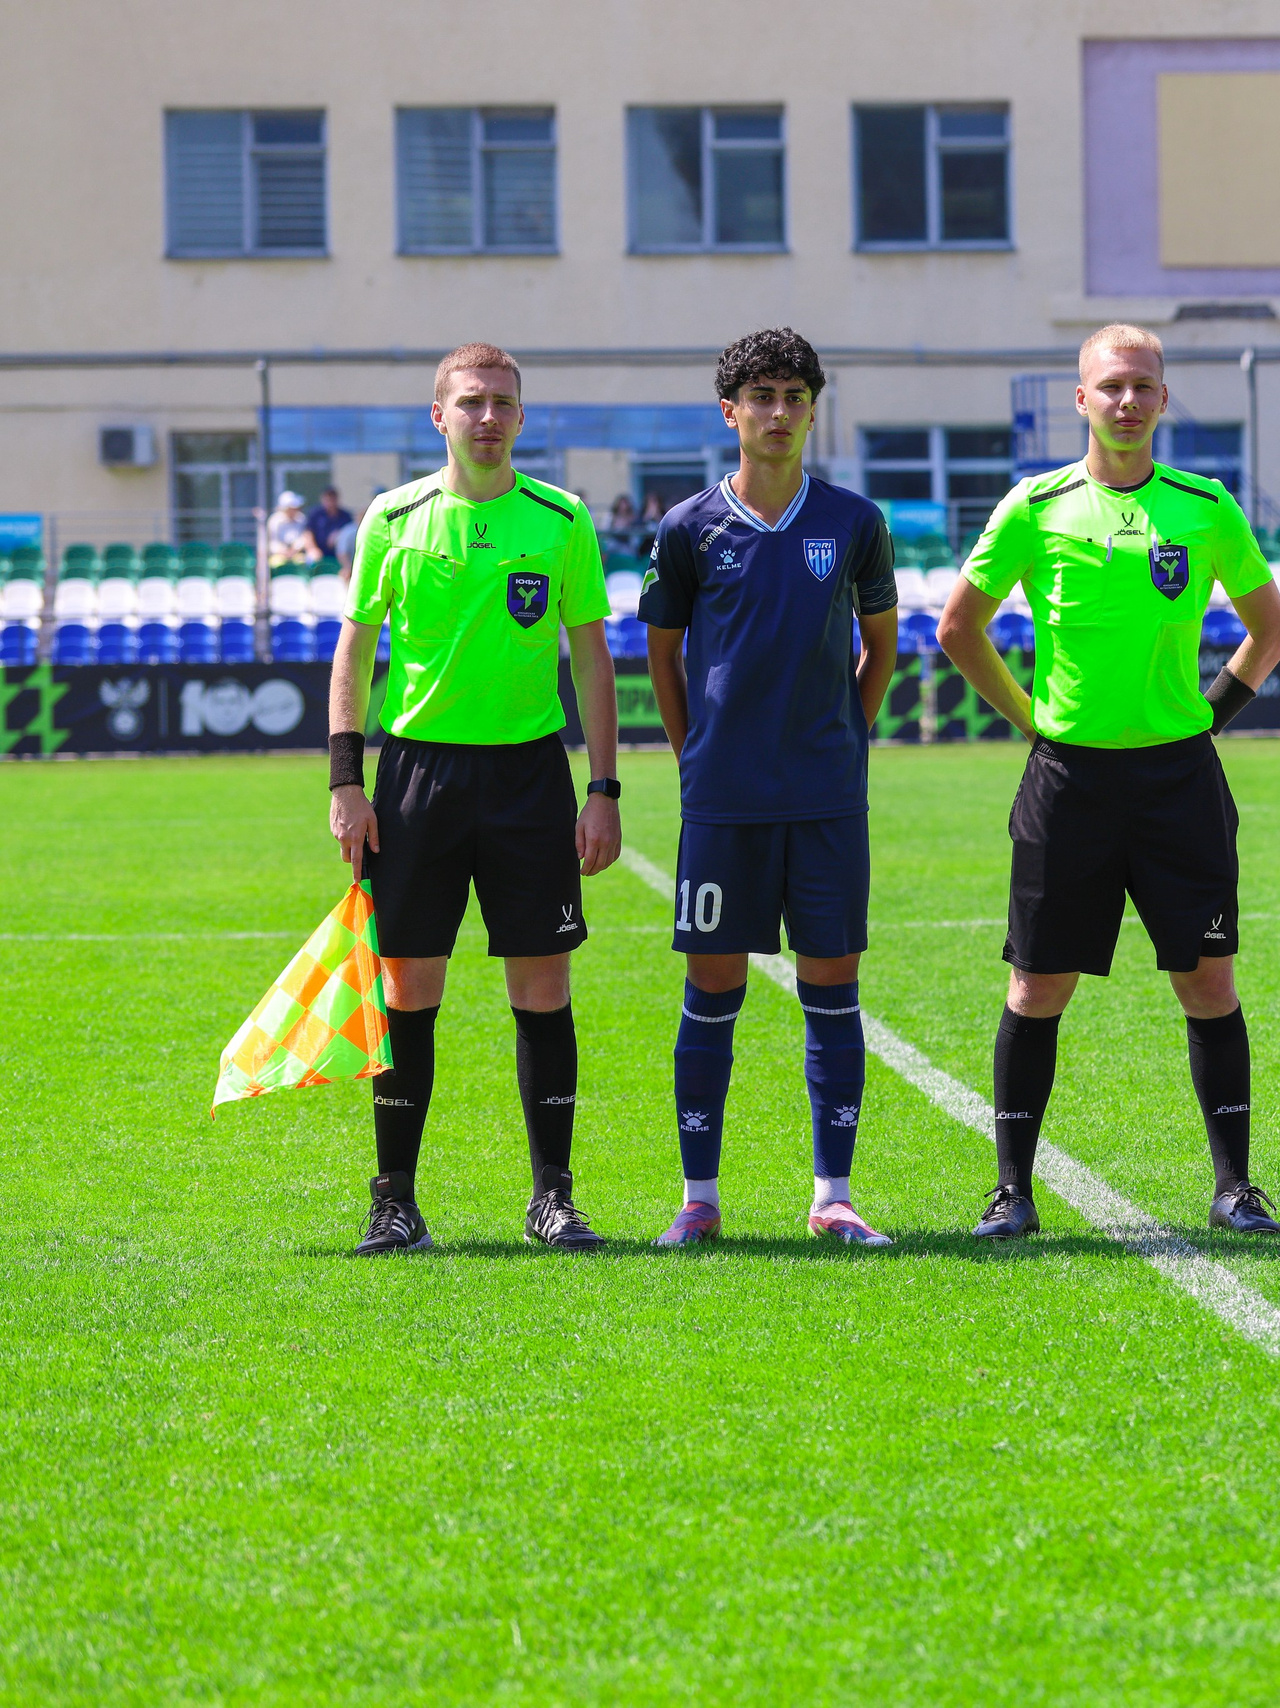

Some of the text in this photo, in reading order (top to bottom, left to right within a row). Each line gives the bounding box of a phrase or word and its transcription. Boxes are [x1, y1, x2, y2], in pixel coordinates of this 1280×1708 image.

[706, 512, 737, 545] SYNERGETIC
[467, 541, 497, 549] JÖGEL
[716, 562, 742, 571] KELME
[676, 879, 723, 932] 10
[556, 922, 579, 933] JÖGEL
[540, 1094, 576, 1105] JÖGE
[1212, 1104, 1250, 1115] JÖGEL
[996, 1111, 1034, 1120] JÖGEL
[680, 1123, 710, 1132] KELME
